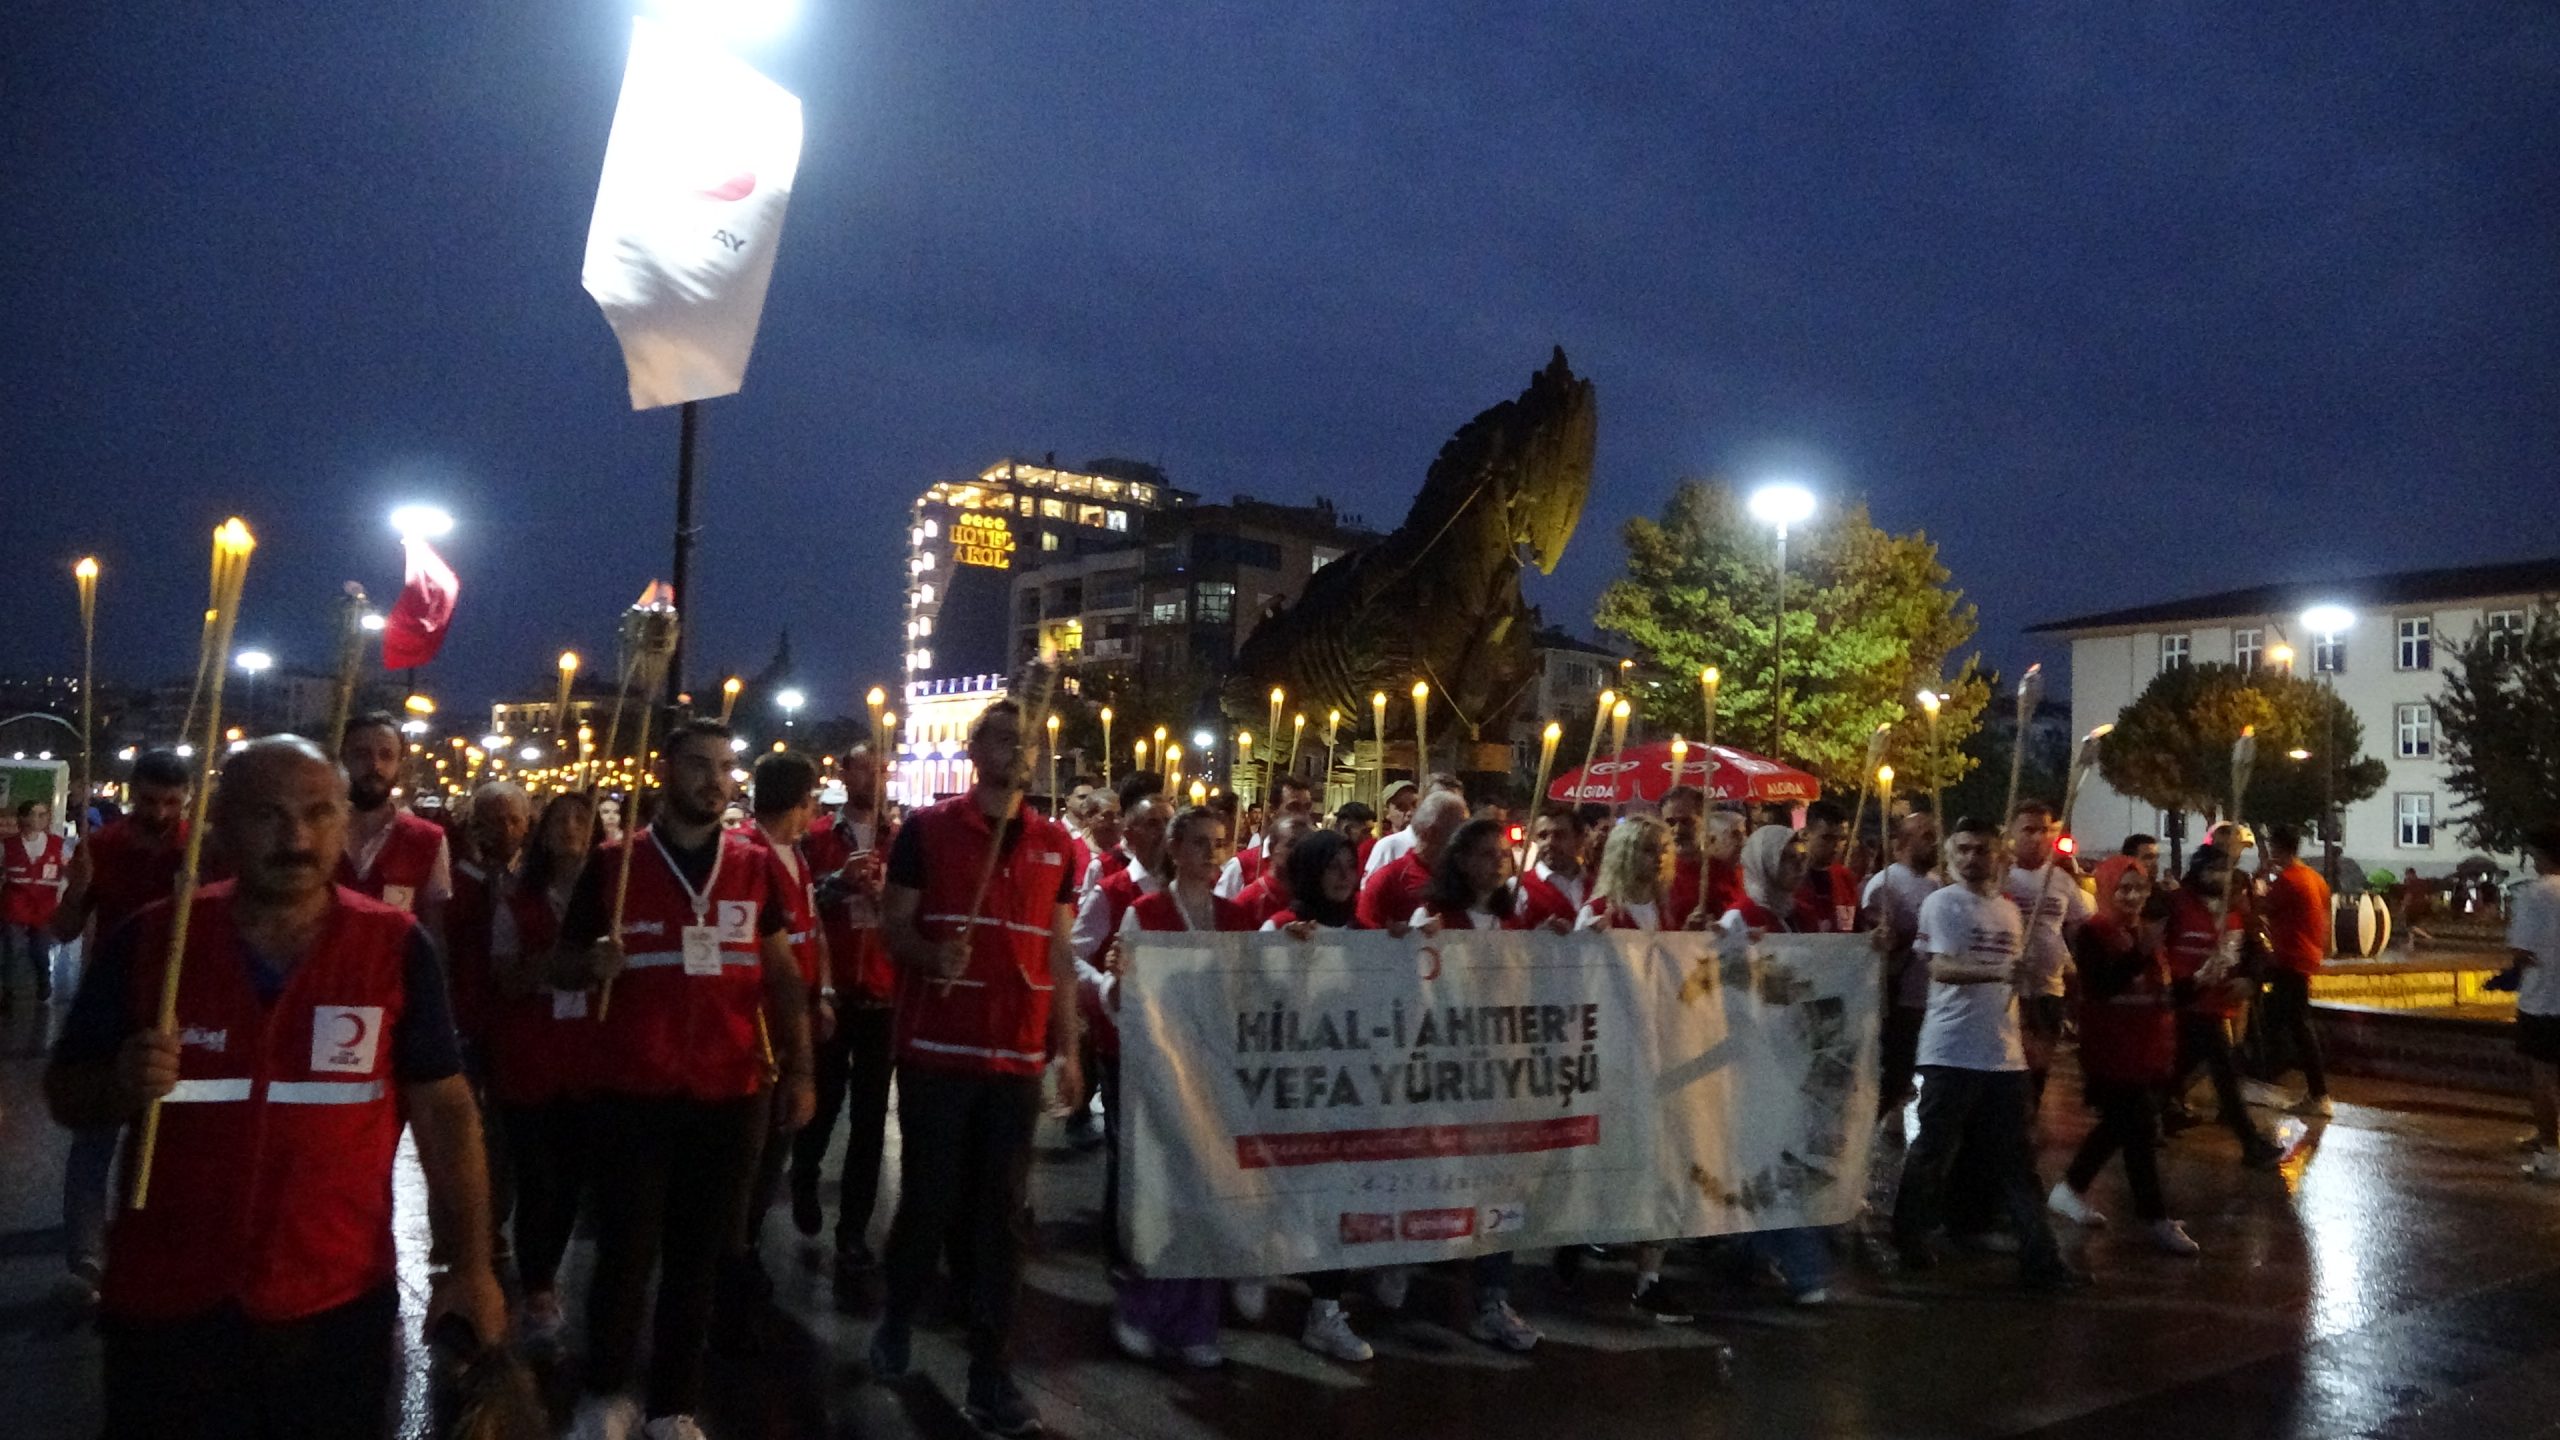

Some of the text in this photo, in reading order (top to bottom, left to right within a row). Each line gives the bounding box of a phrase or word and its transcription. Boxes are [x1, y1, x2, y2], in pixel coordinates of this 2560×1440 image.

[949, 525, 1016, 551] HOTEL
[1236, 1045, 1597, 1109] VEFA YÜRÜYÜŞÜ
